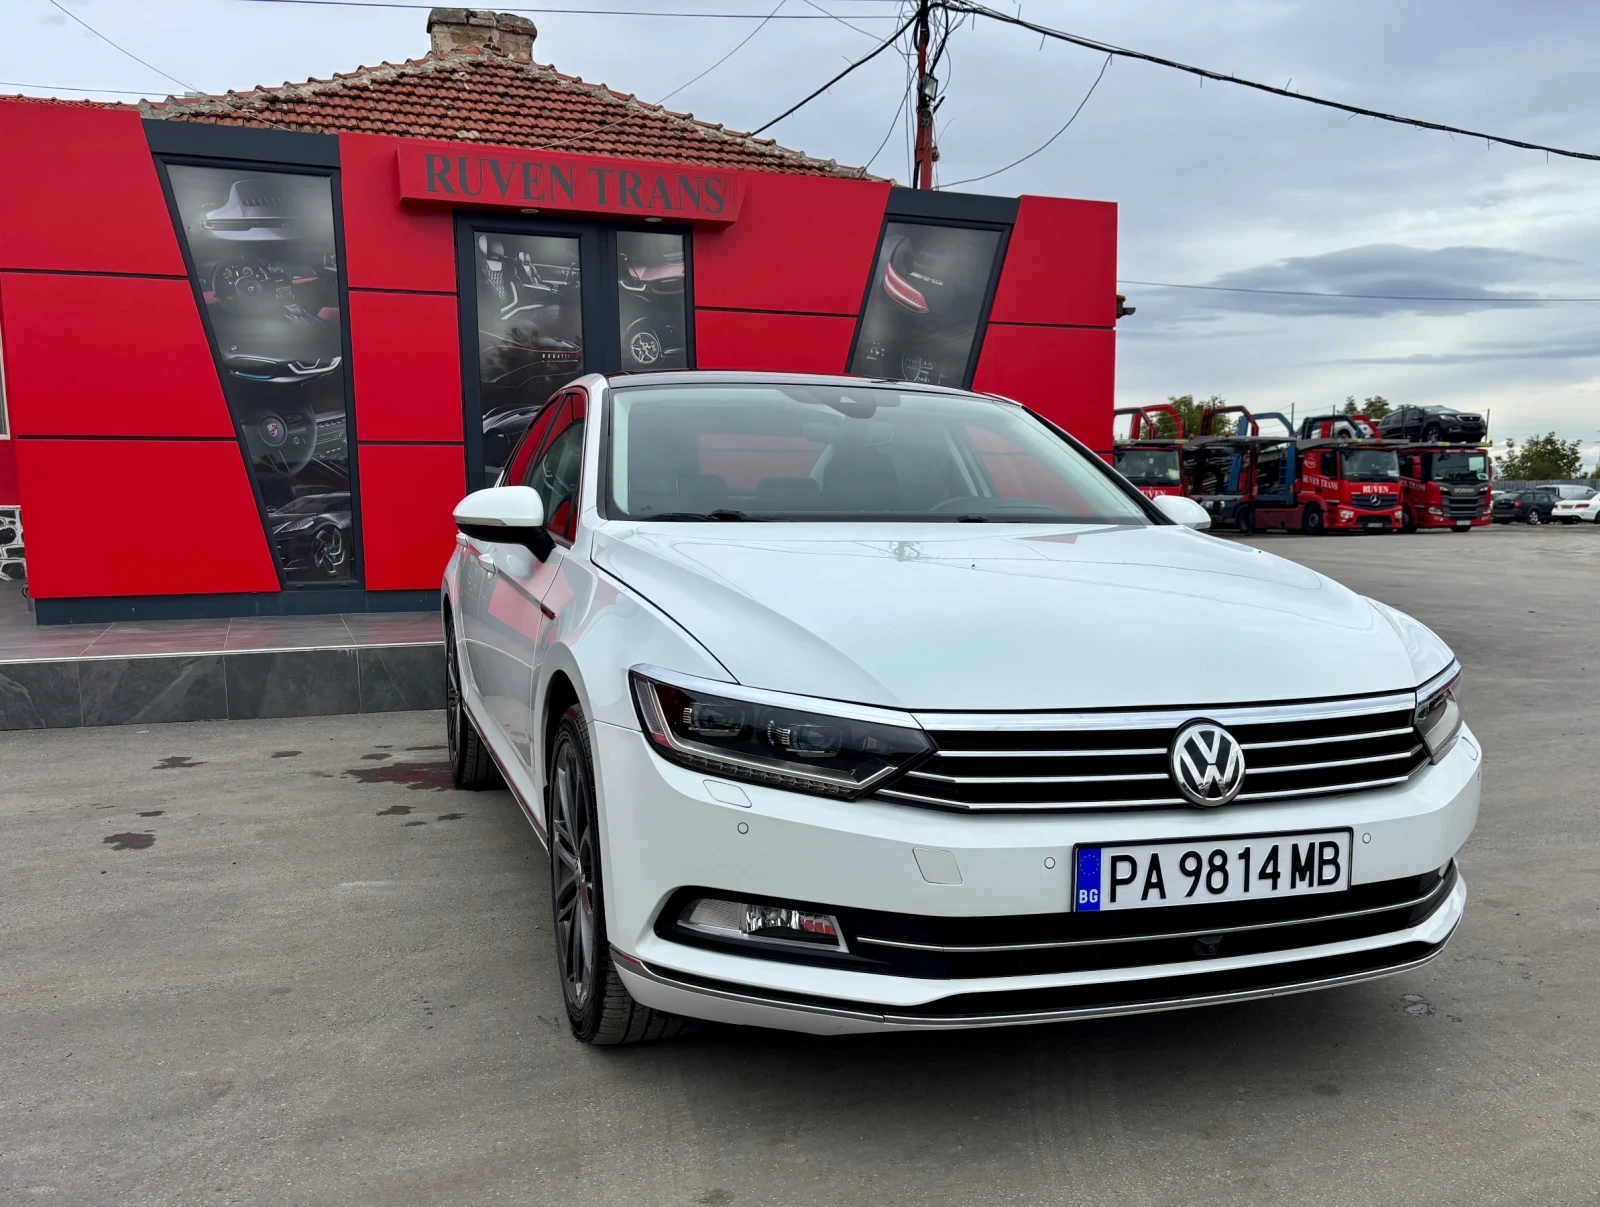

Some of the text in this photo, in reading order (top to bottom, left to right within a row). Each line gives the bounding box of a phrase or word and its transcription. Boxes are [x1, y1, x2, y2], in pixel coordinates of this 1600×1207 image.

[424, 152, 726, 215] RUVEN TRANS
[1302, 475, 1339, 490] RUVEN TRANS
[1362, 485, 1389, 494] RUVEN
[1141, 490, 1166, 498] UVEN
[1108, 840, 1341, 904] PA 9814 MB
[1078, 888, 1099, 904] BG
